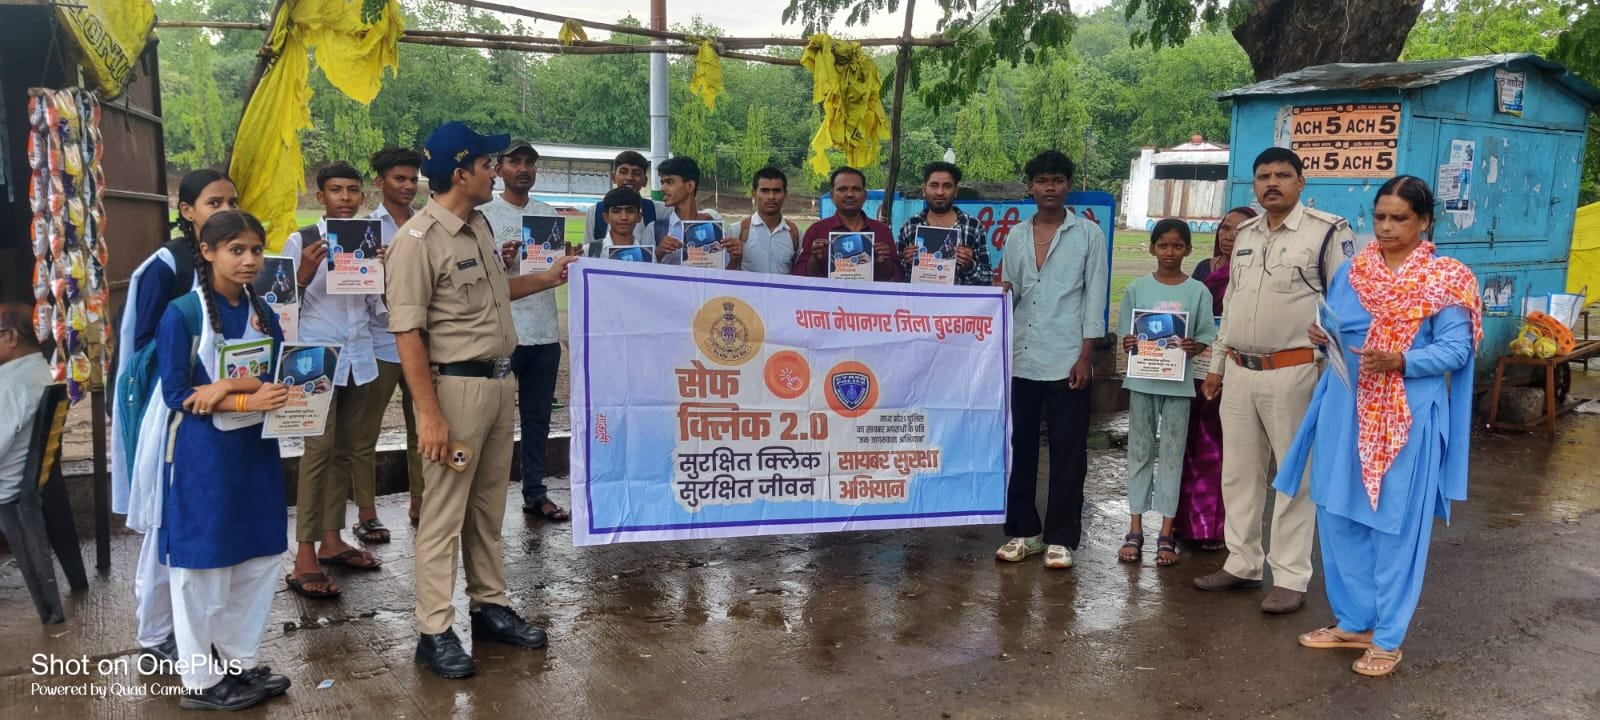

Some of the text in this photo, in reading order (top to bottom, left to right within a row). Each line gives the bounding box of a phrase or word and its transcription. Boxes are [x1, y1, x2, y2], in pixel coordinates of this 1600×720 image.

[1294, 116, 1341, 135] ACH 5
[1346, 115, 1396, 134] ACH 5
[1302, 152, 1339, 170] CH 5
[1342, 152, 1393, 170] ACH 5
[796, 306, 993, 341] थाना नेपानगर जिला बुरहानपुर
[675, 360, 740, 398] सेफ
[677, 402, 828, 441] क्लिक 2.0
[678, 446, 821, 479] सुरक्षित क्लिक
[837, 450, 939, 475] सायबर सुरक्षा
[677, 473, 816, 507] सुरक्षित जीवन
[839, 475, 906, 499] अभियान
